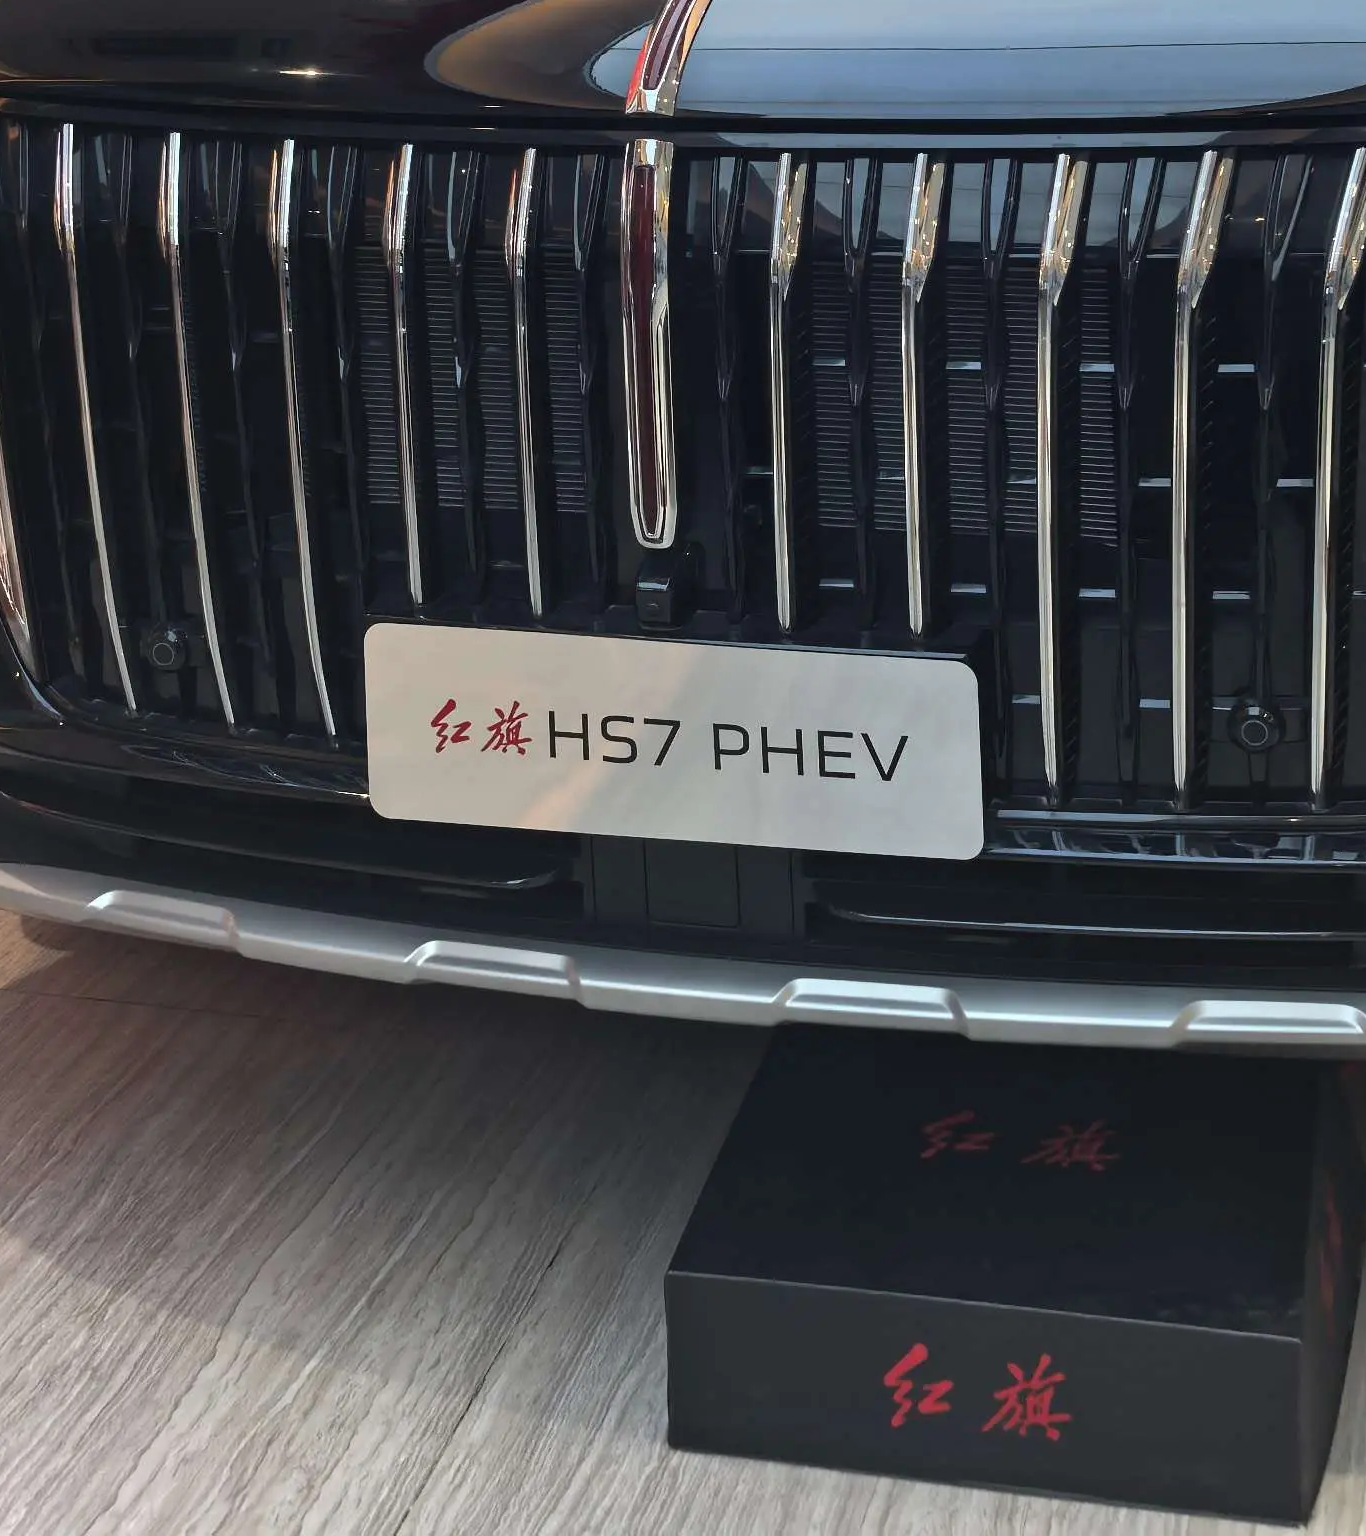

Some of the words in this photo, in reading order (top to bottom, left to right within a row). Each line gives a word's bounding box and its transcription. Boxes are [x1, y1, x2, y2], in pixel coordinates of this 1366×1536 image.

[547, 710, 682, 767] HS7
[712, 722, 909, 782] PHEV
[883, 1343, 1073, 1441] 红旗
